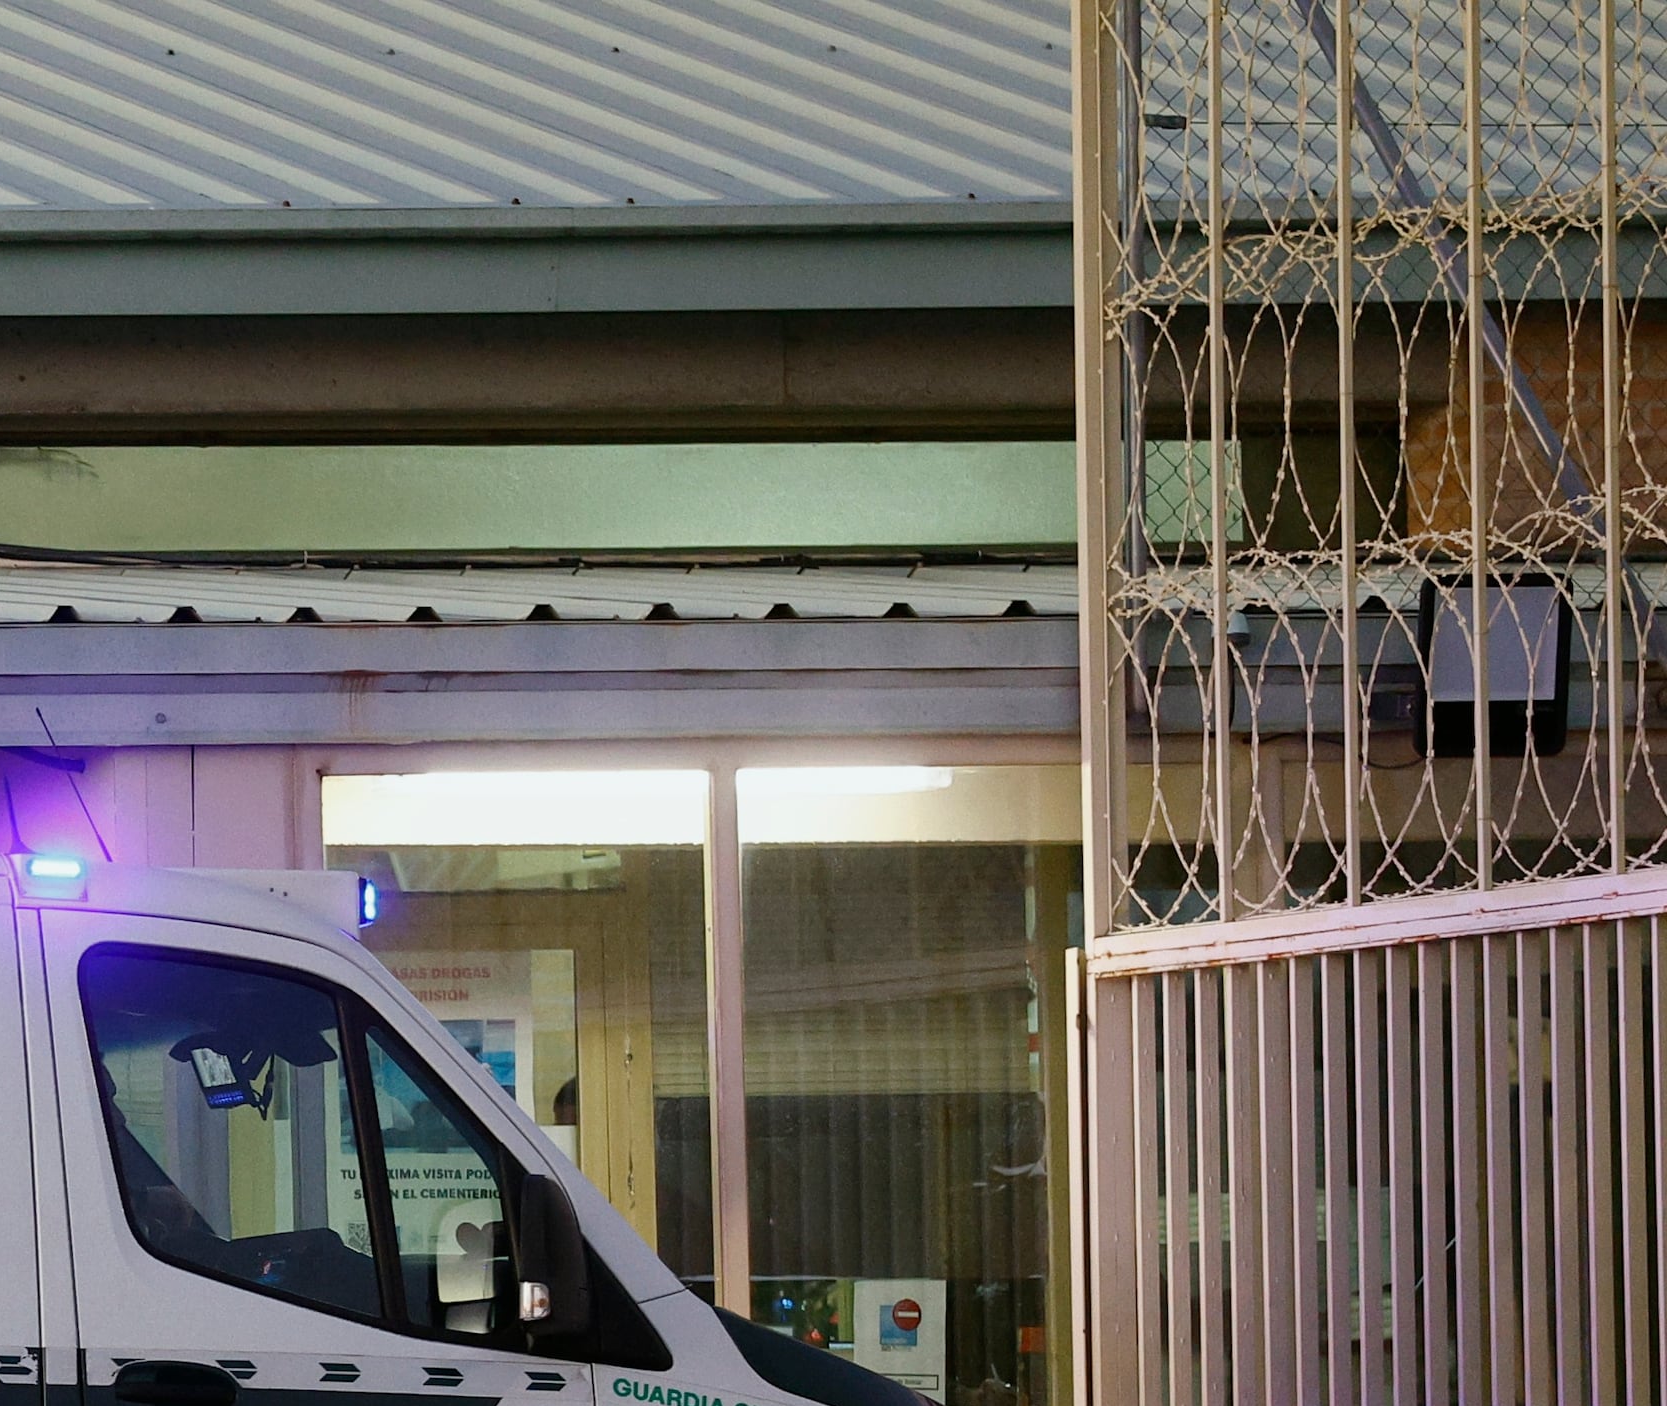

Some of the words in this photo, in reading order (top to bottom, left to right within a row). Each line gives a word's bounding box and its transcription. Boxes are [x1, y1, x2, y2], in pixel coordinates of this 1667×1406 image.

[431, 966, 491, 979] DROGAS
[340, 1169, 356, 1180] TU
[423, 1169, 462, 1180] VISITA
[403, 1189, 417, 1199] EL
[420, 1188, 501, 1199] CEMENTERIO
